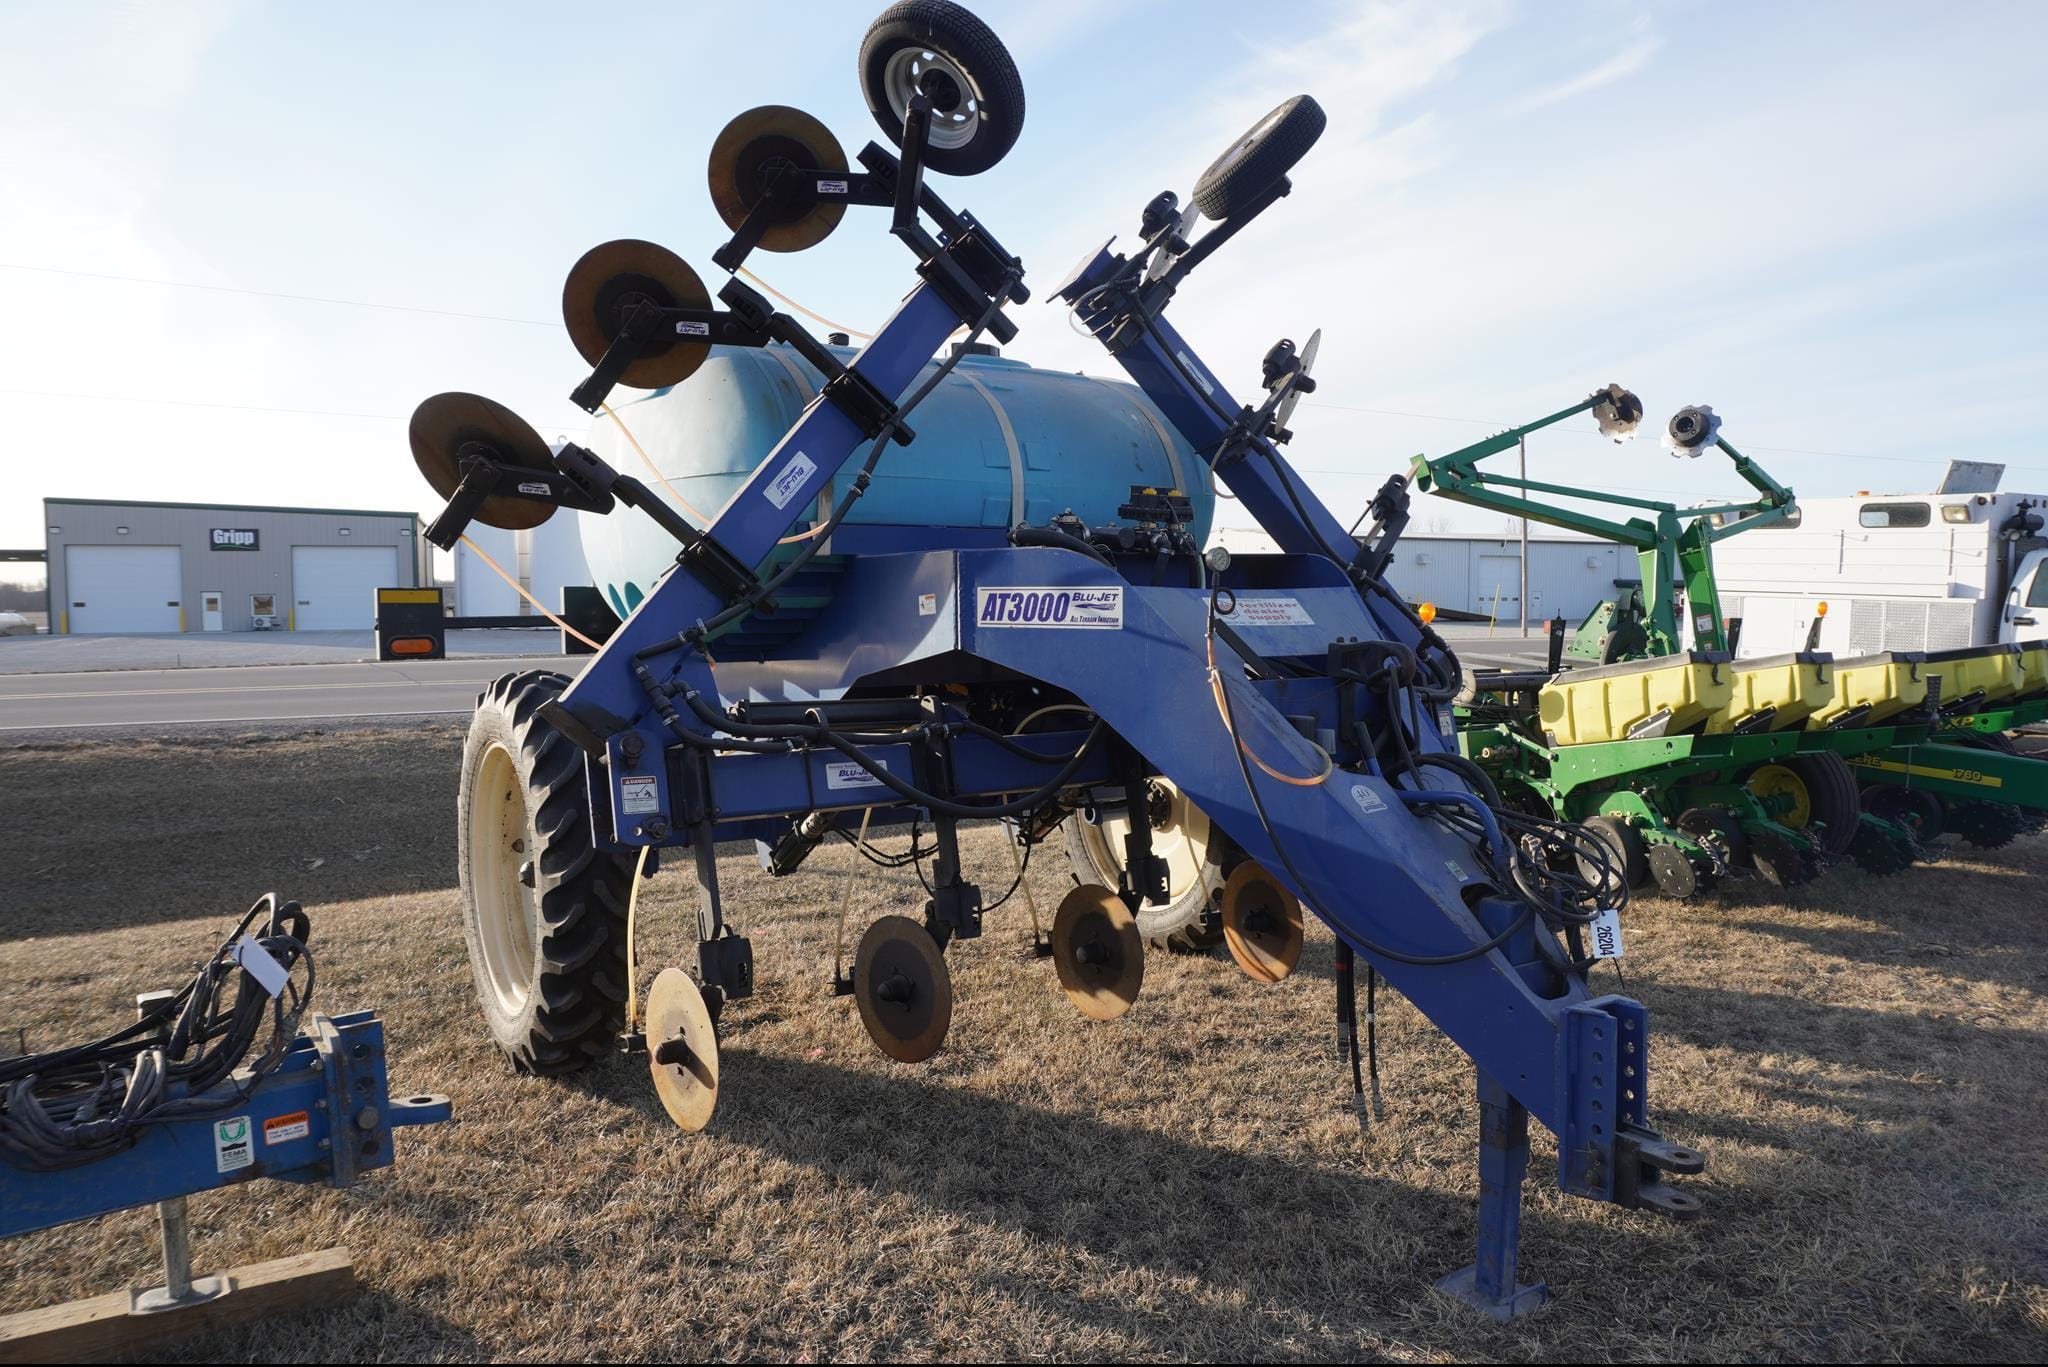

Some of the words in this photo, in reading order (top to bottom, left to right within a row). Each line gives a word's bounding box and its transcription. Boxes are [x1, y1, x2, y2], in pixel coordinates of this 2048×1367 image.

[780, 466, 805, 497] BLU-JET
[213, 529, 255, 546] Gripp
[1072, 592, 1119, 602] BLU-JET
[981, 592, 1071, 622] AT3000
[1952, 768, 1982, 781] 1760
[1596, 926, 1615, 956] 26204
[222, 1148, 248, 1159] FEMA
